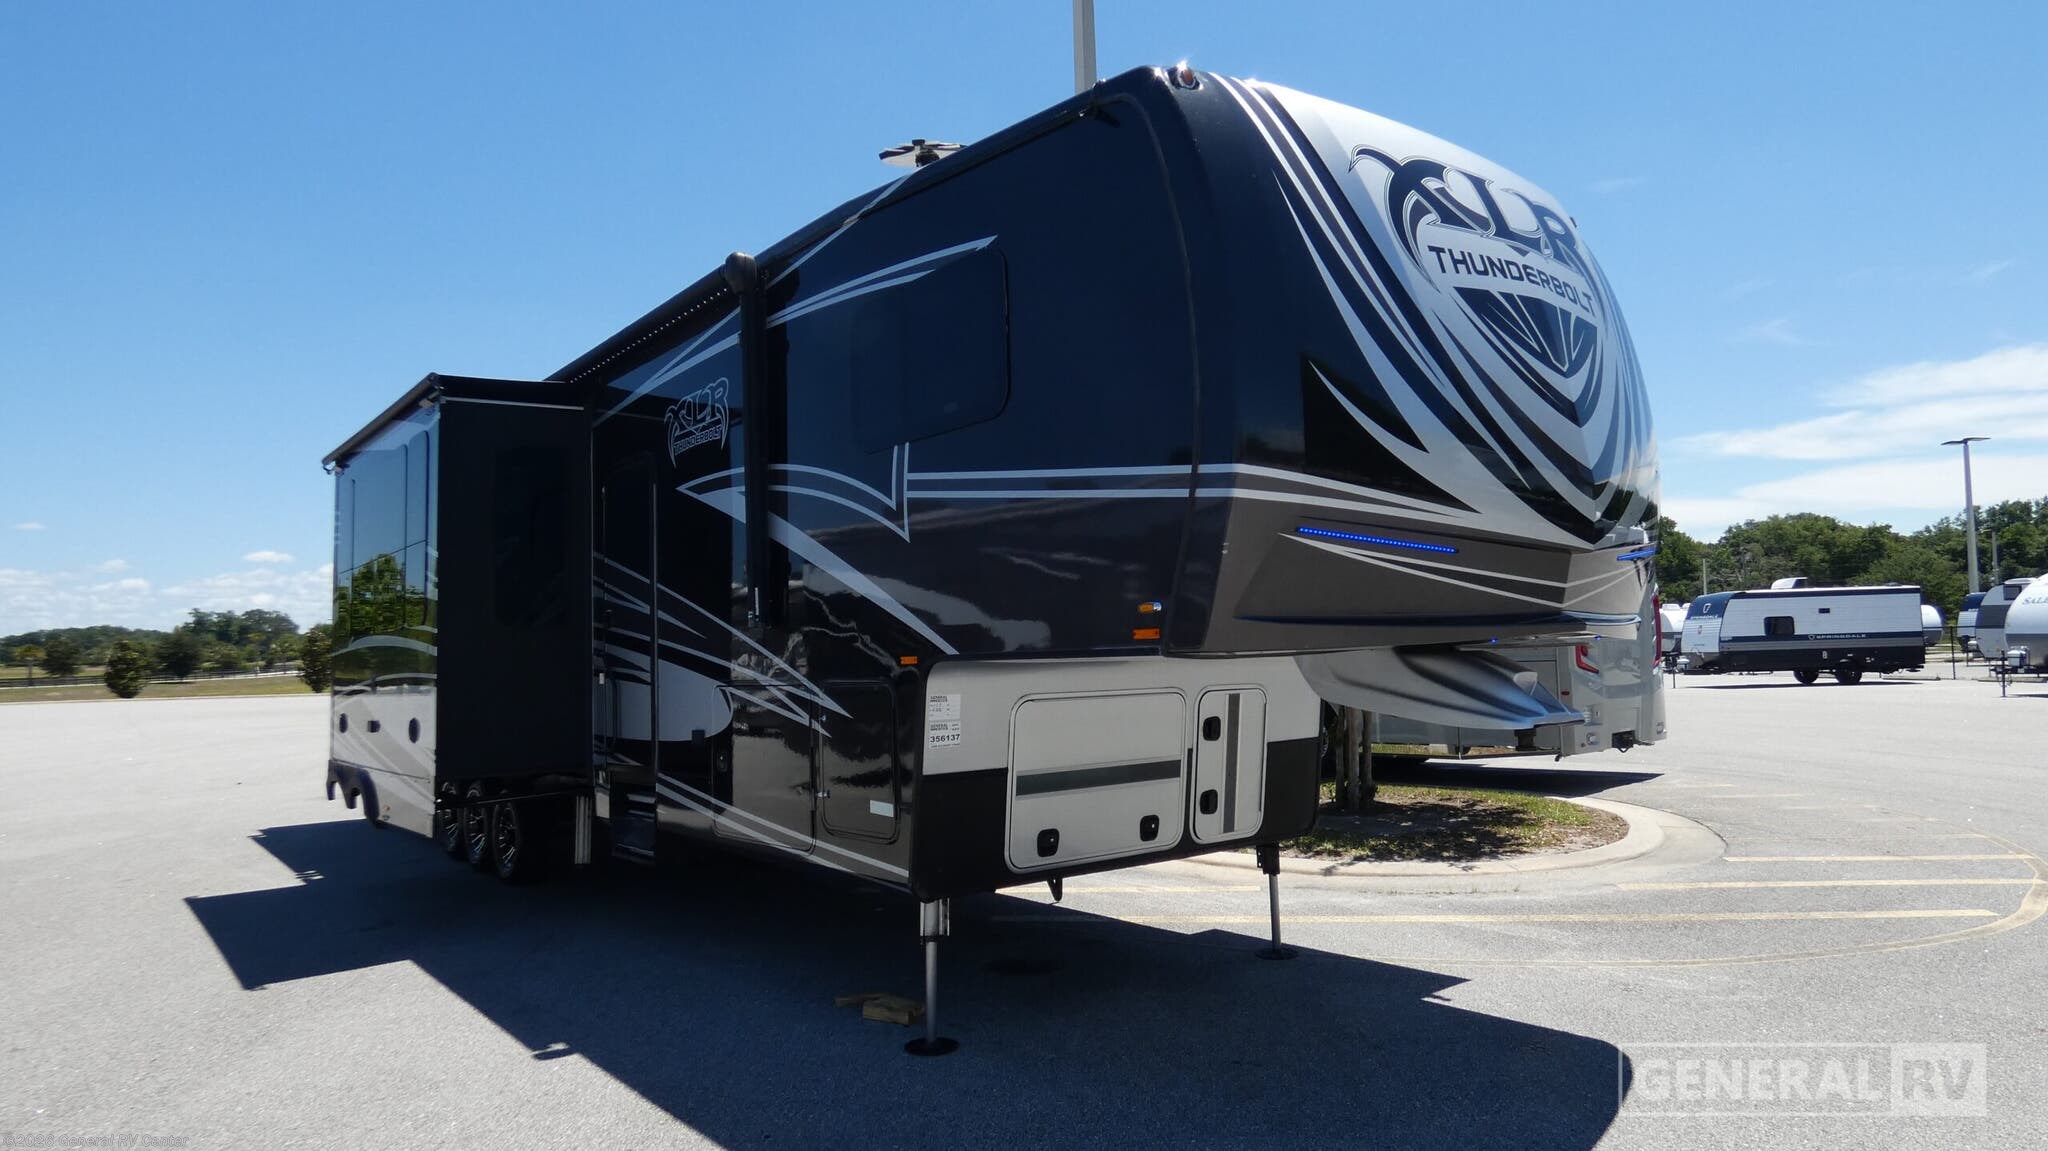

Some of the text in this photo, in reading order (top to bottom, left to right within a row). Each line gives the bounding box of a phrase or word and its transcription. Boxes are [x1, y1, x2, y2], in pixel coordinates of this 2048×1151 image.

[1349, 144, 1592, 285] XLR
[1427, 245, 1597, 318] THUNDERBOLT
[664, 377, 729, 460] XLR
[673, 424, 722, 456] THUNDERBOLT
[930, 733, 960, 743] 356137
